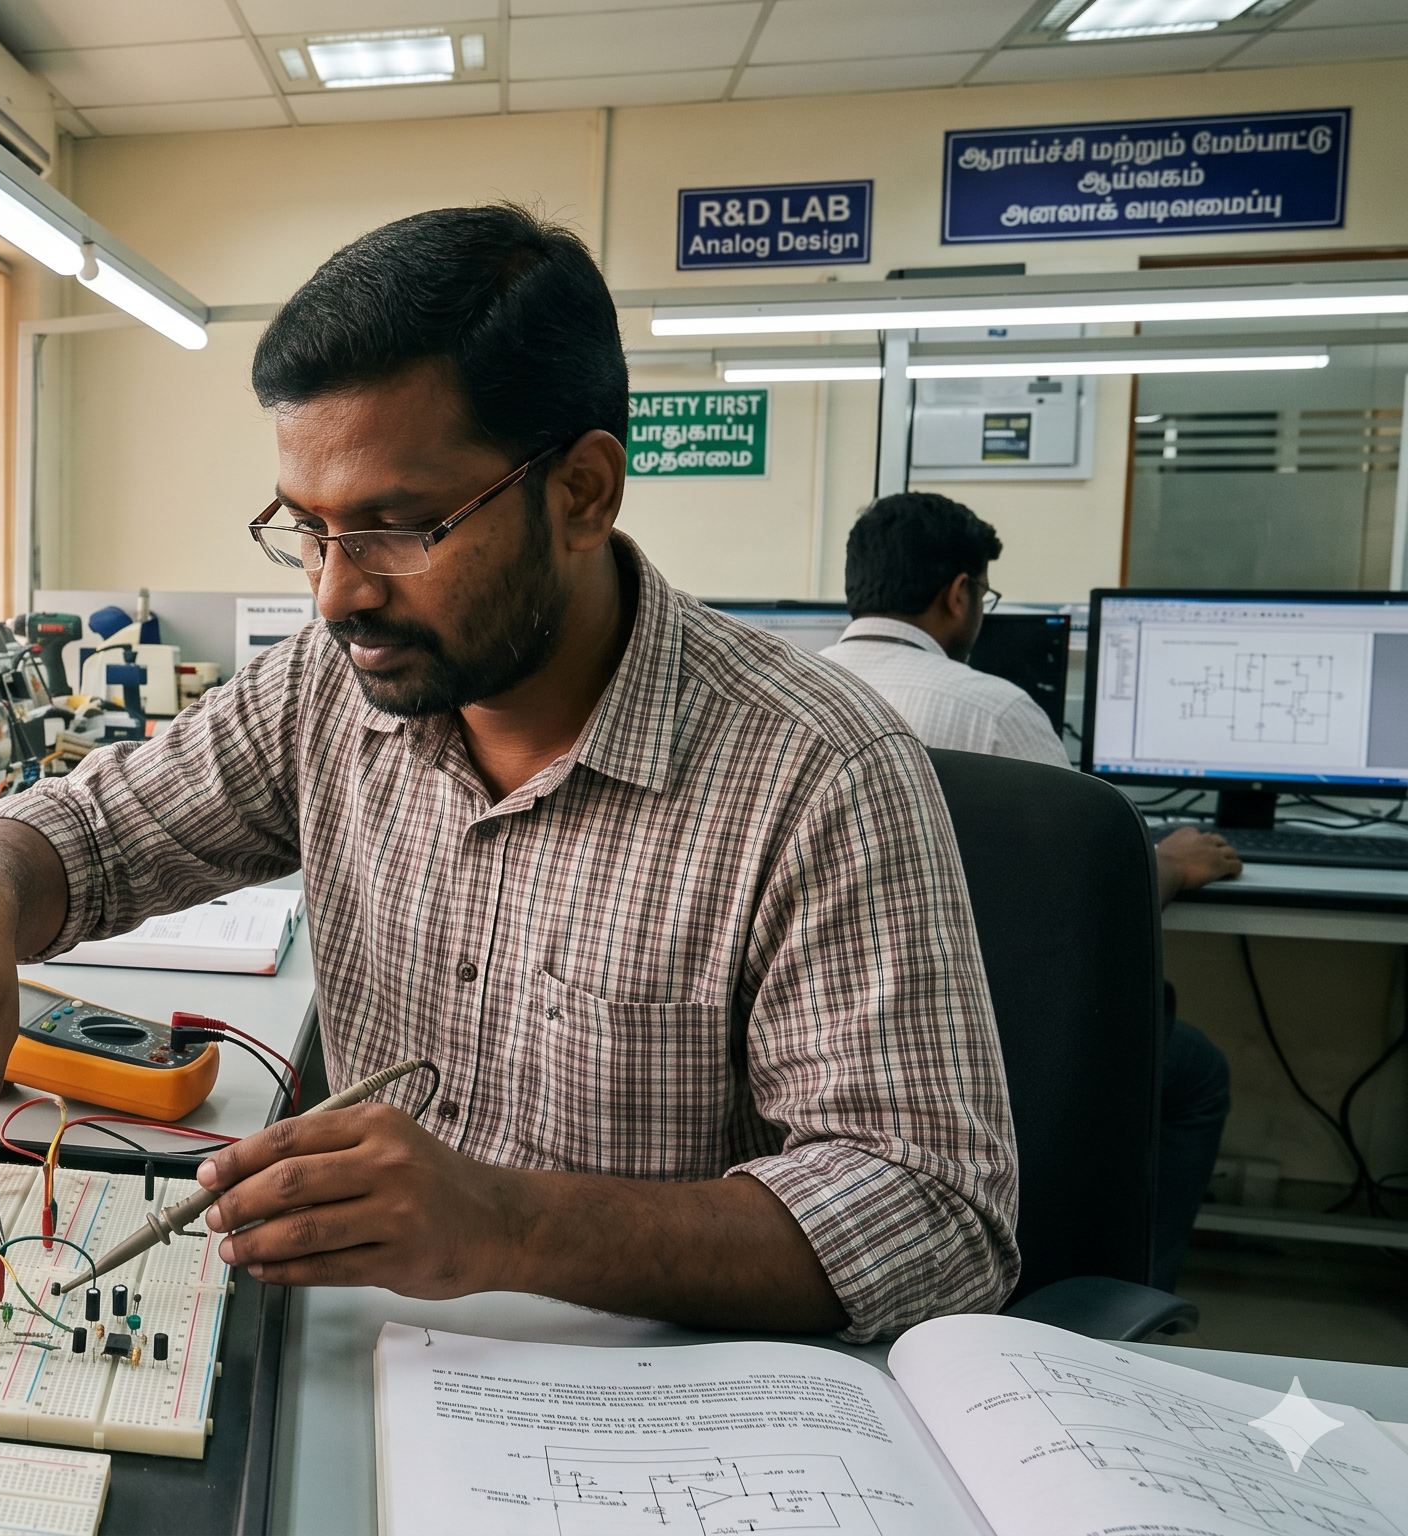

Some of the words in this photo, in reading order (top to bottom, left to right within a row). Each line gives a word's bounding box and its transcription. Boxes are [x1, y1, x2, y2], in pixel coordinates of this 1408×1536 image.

[958, 138, 1085, 171] ஆராய்ச்சி
[1092, 132, 1186, 167] மற்றும்
[1192, 125, 1333, 155] மேம்பாட்டு
[1078, 162, 1205, 195] ஆய்வகம்
[699, 198, 771, 228] R&D
[782, 195, 851, 224] LAB
[1001, 197, 1119, 226] அனலாக்
[1125, 190, 1283, 223] வடிவமைப்பு
[688, 233, 770, 258] Analog
[778, 229, 859, 254] Design
[629, 396, 701, 418] SAFETY
[705, 395, 761, 416] FIRST
[631, 416, 754, 449] பாதுகாப்பு
[632, 443, 753, 473] முதன்மை
